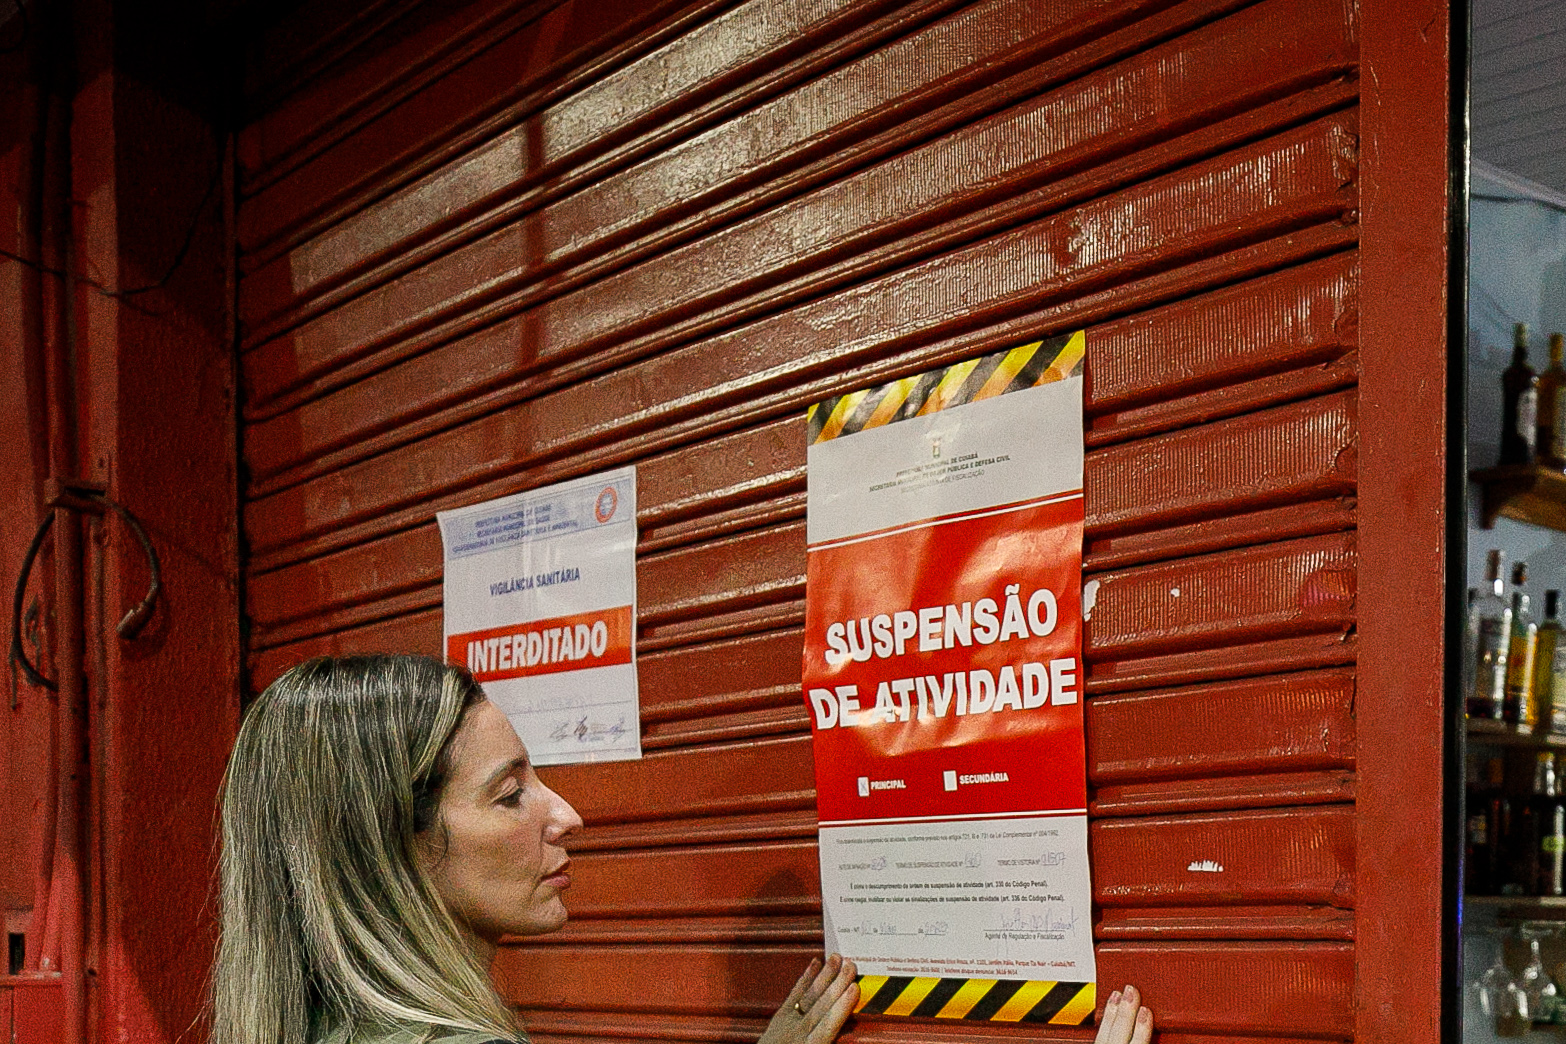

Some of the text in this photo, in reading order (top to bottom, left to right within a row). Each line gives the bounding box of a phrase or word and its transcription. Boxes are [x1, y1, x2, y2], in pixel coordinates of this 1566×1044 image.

[490, 567, 580, 596] VIGILÂNCIA SANITÁRIA
[467, 620, 608, 673] INTERDITADO
[824, 583, 1059, 666] SUSPENSÃO
[808, 658, 1078, 730] DE ATIVIDADE
[870, 771, 1009, 791] PRINCIPAL SECUNDÁRIA
